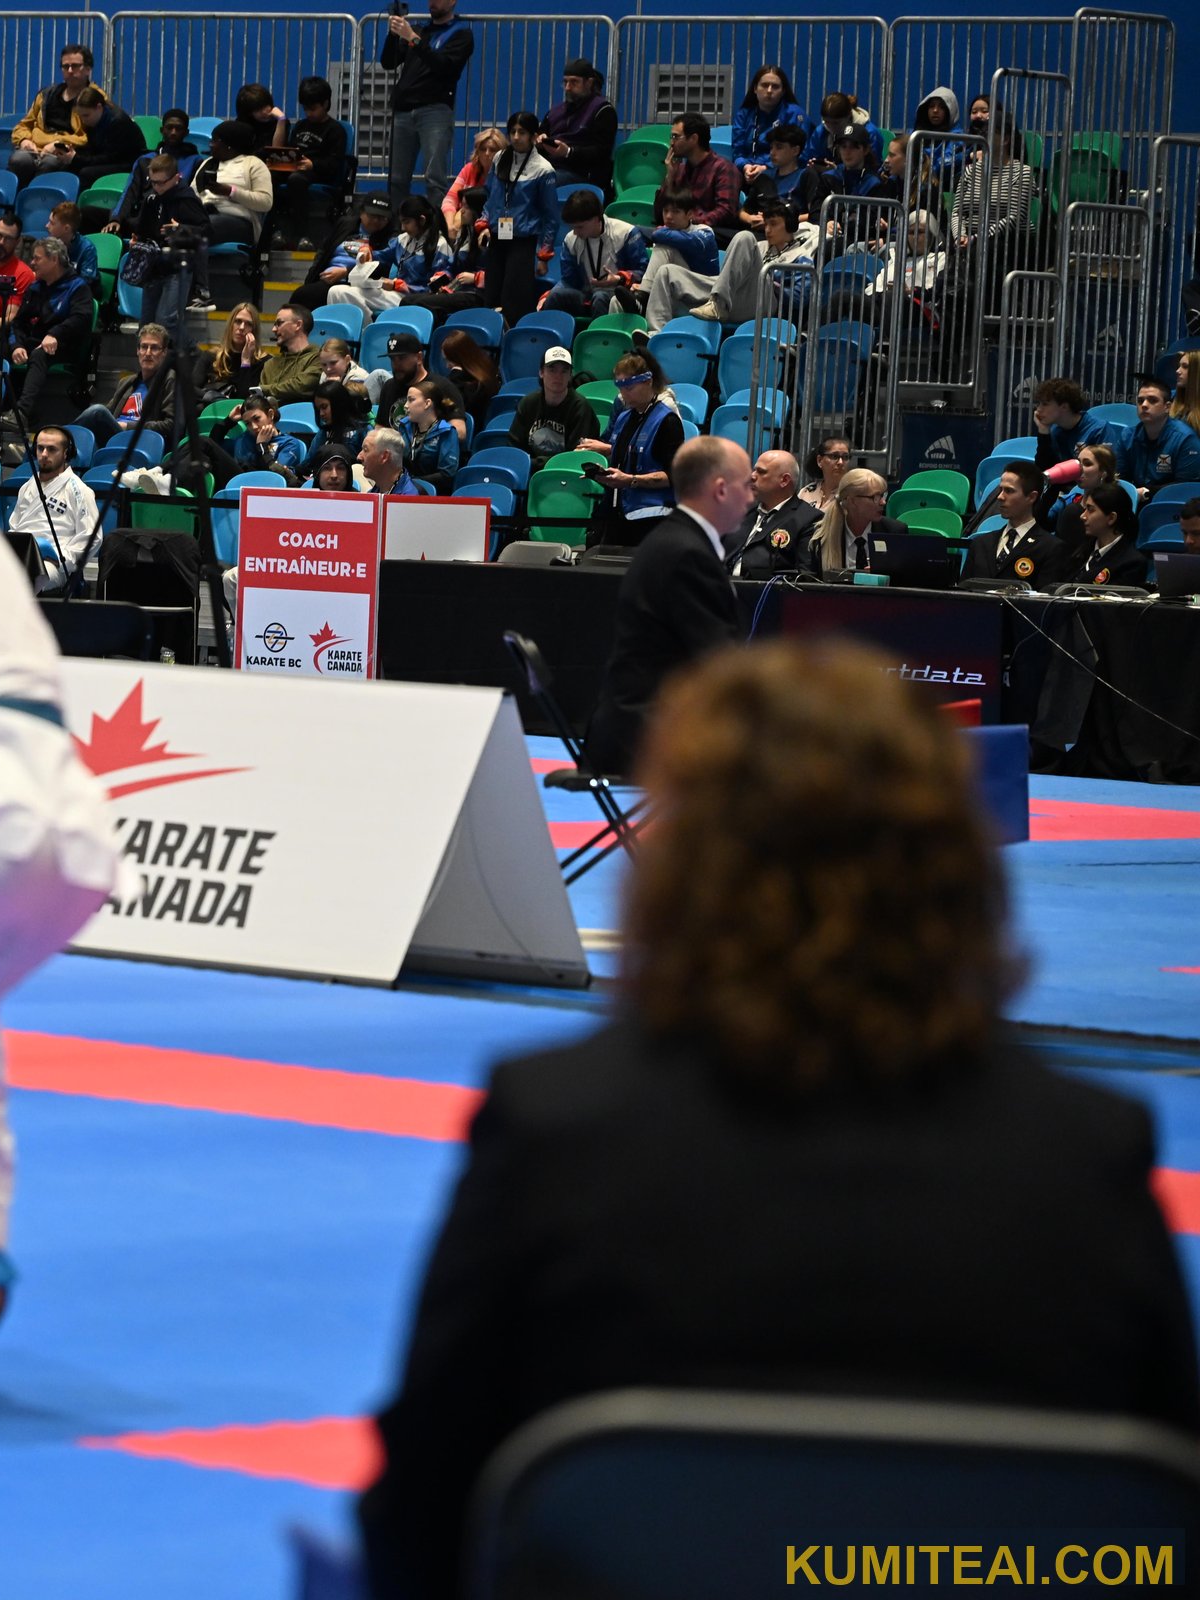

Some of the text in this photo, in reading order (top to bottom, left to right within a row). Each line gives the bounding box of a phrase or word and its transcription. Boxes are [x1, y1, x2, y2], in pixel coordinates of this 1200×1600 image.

[278, 531, 338, 550] COACH
[244, 555, 366, 577] ENTRAÎNEUR·E
[246, 656, 302, 668] KARATE BC
[327, 650, 362, 662] KARATE
[327, 661, 363, 673] CANADA
